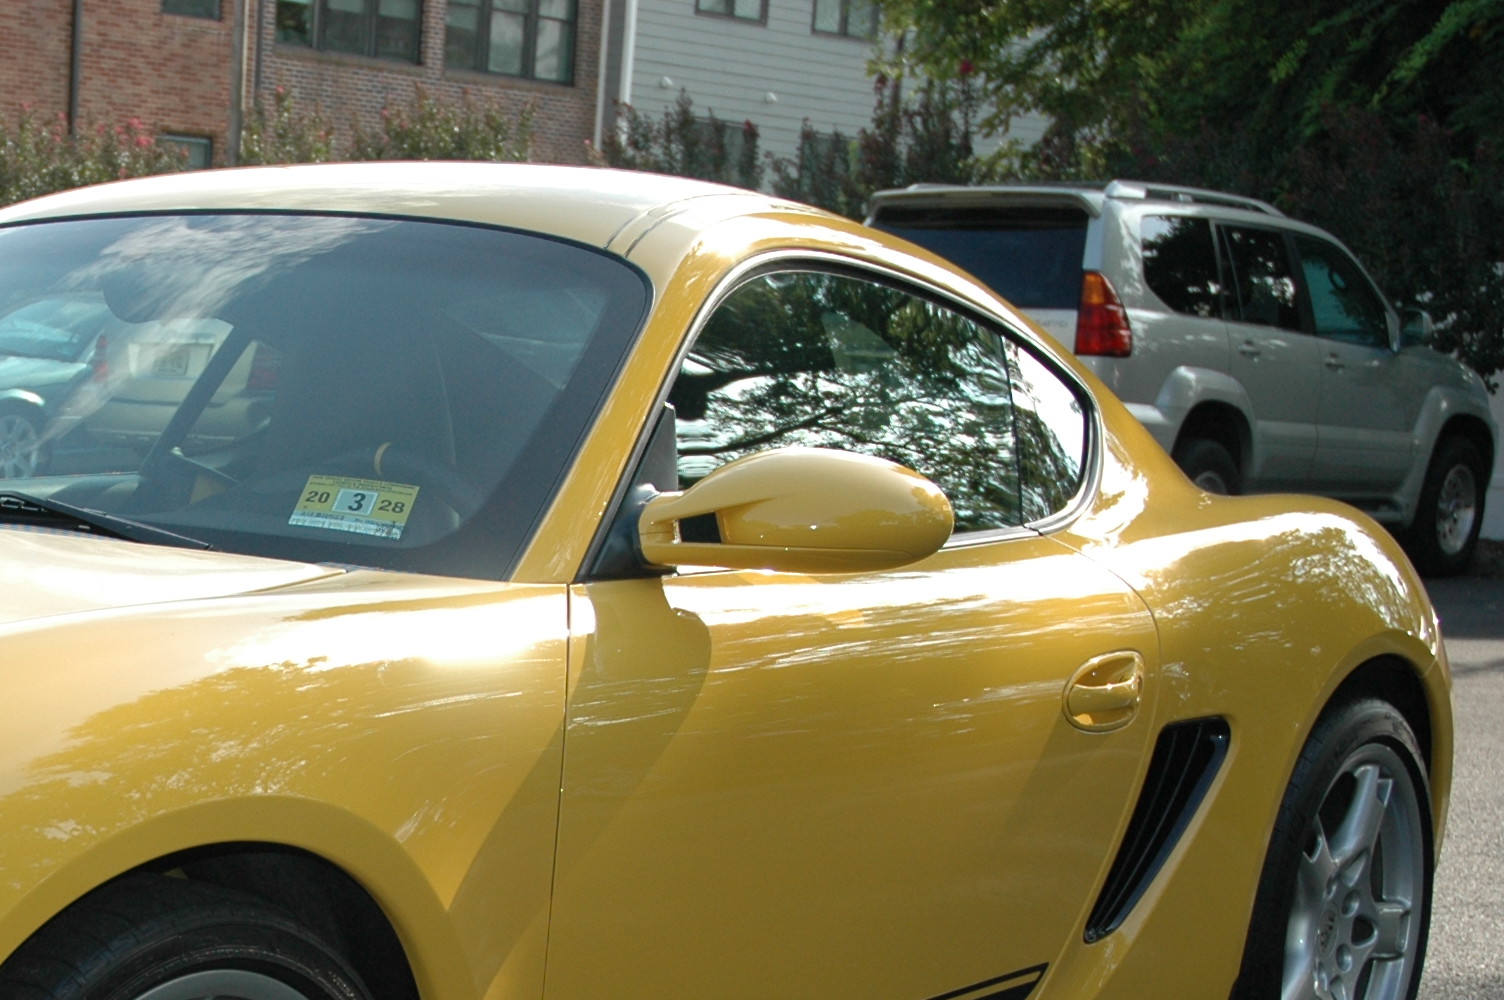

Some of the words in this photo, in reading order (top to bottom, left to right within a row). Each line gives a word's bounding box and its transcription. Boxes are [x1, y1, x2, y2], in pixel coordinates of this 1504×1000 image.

[304, 490, 331, 504] 20
[347, 492, 367, 512] 3
[377, 499, 406, 514] 28
